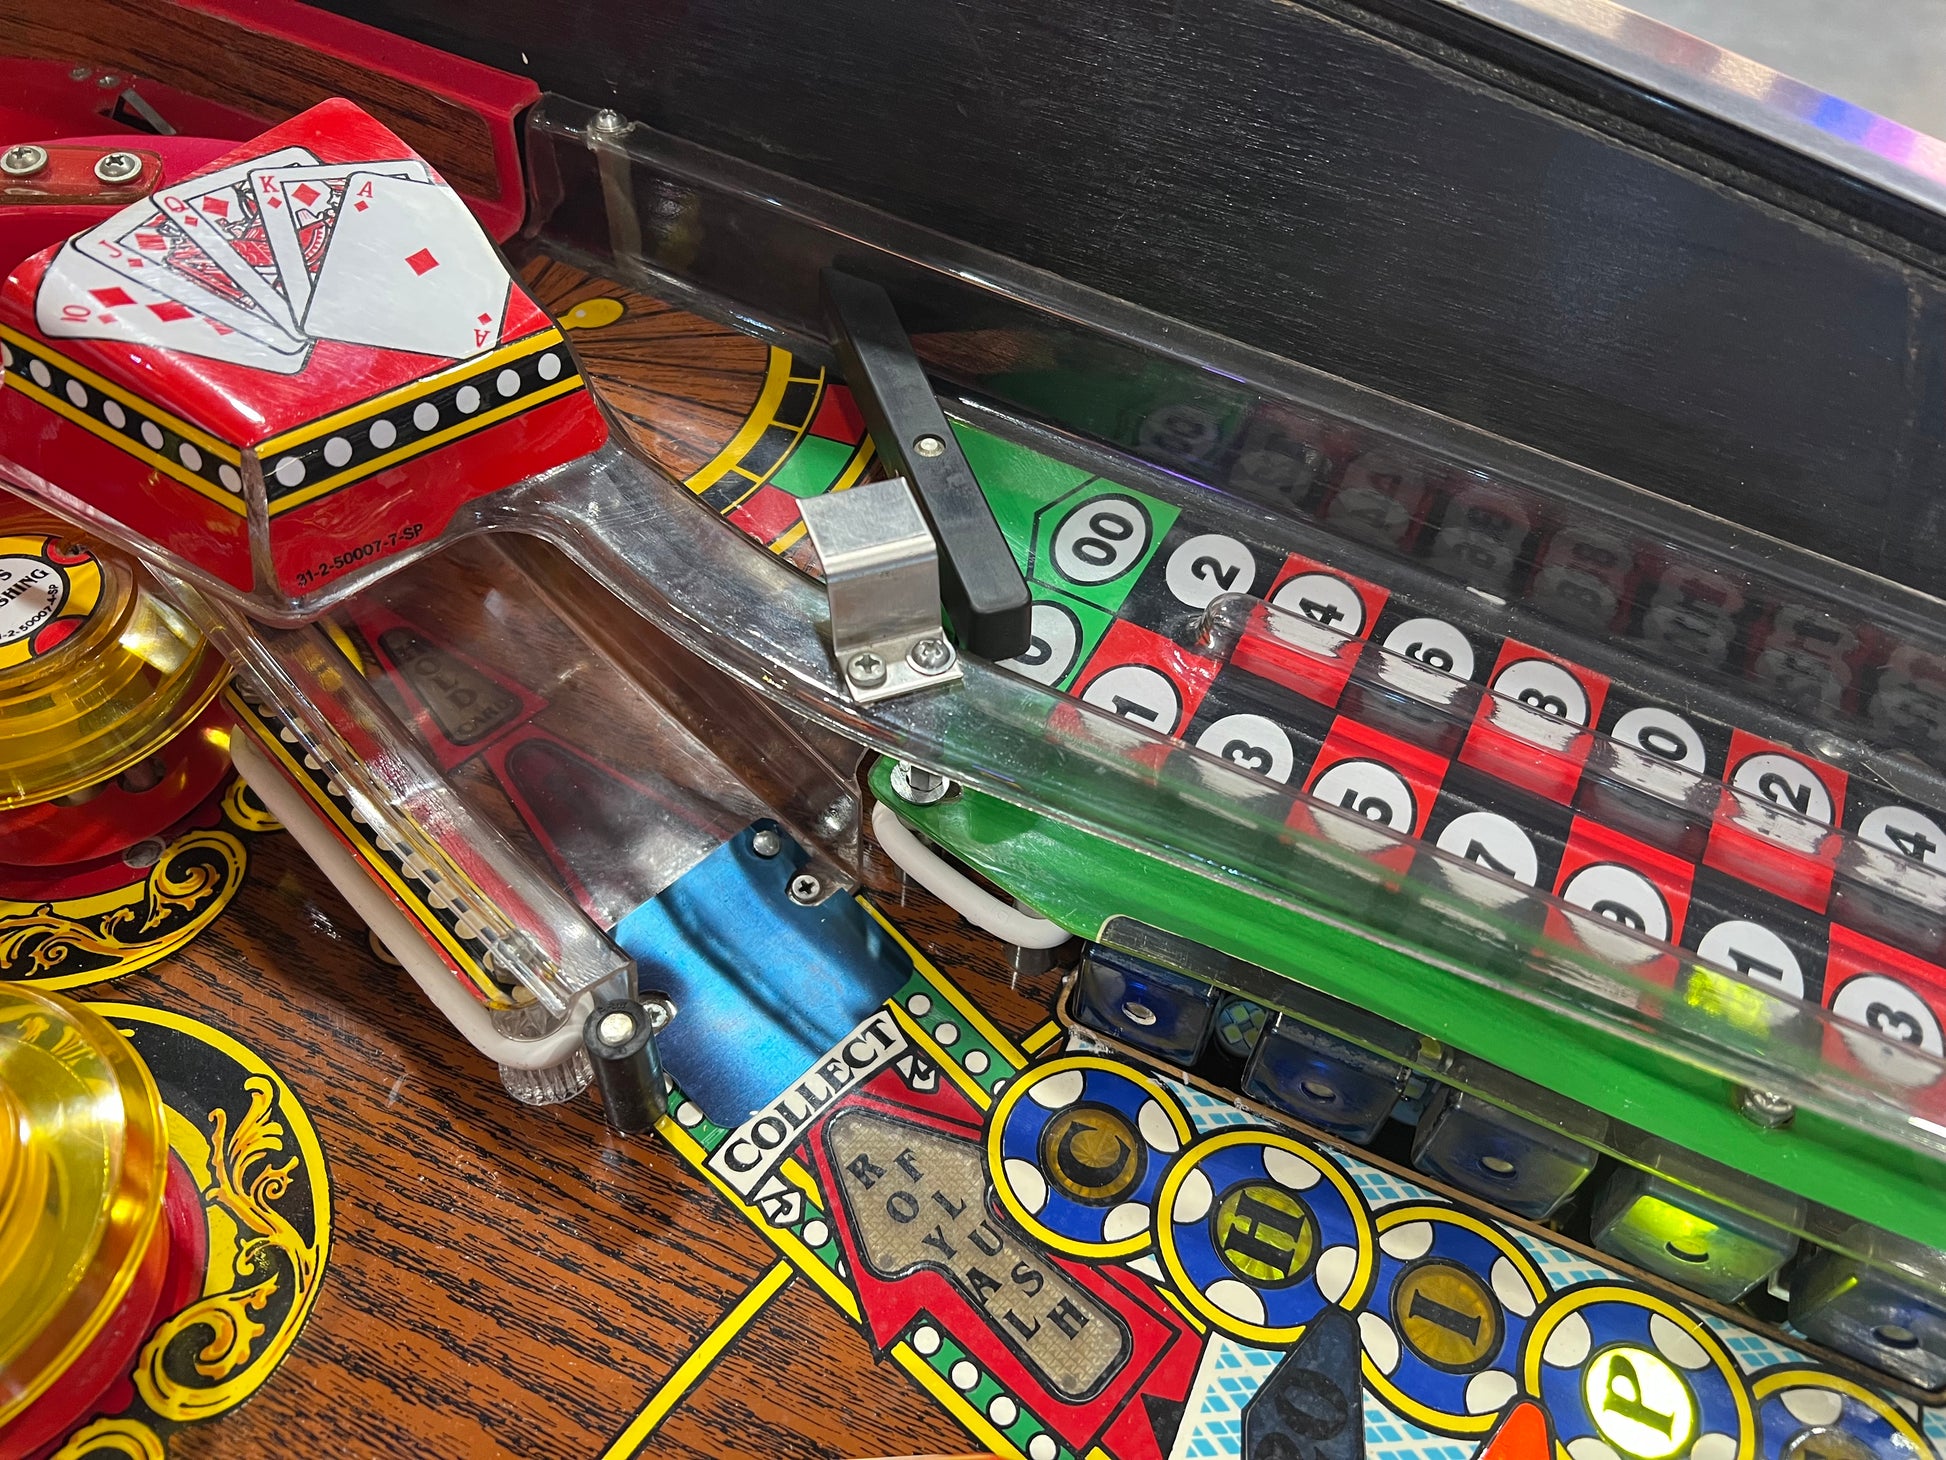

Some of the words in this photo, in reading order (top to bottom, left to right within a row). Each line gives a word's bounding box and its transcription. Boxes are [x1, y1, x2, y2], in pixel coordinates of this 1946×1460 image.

[259, 175, 279, 194] K
[357, 181, 374, 198] A
[164, 196, 188, 213] Q
[98, 240, 122, 258] J
[60, 304, 92, 323] 10
[474, 327, 490, 347] A
[1071, 511, 1134, 566] 00
[1191, 556, 1241, 591] 2
[724, 1018, 896, 1173] COLLECT
[1056, 1120, 1131, 1187] C
[1223, 1189, 1306, 1281] H
[1602, 1353, 1674, 1443] P
